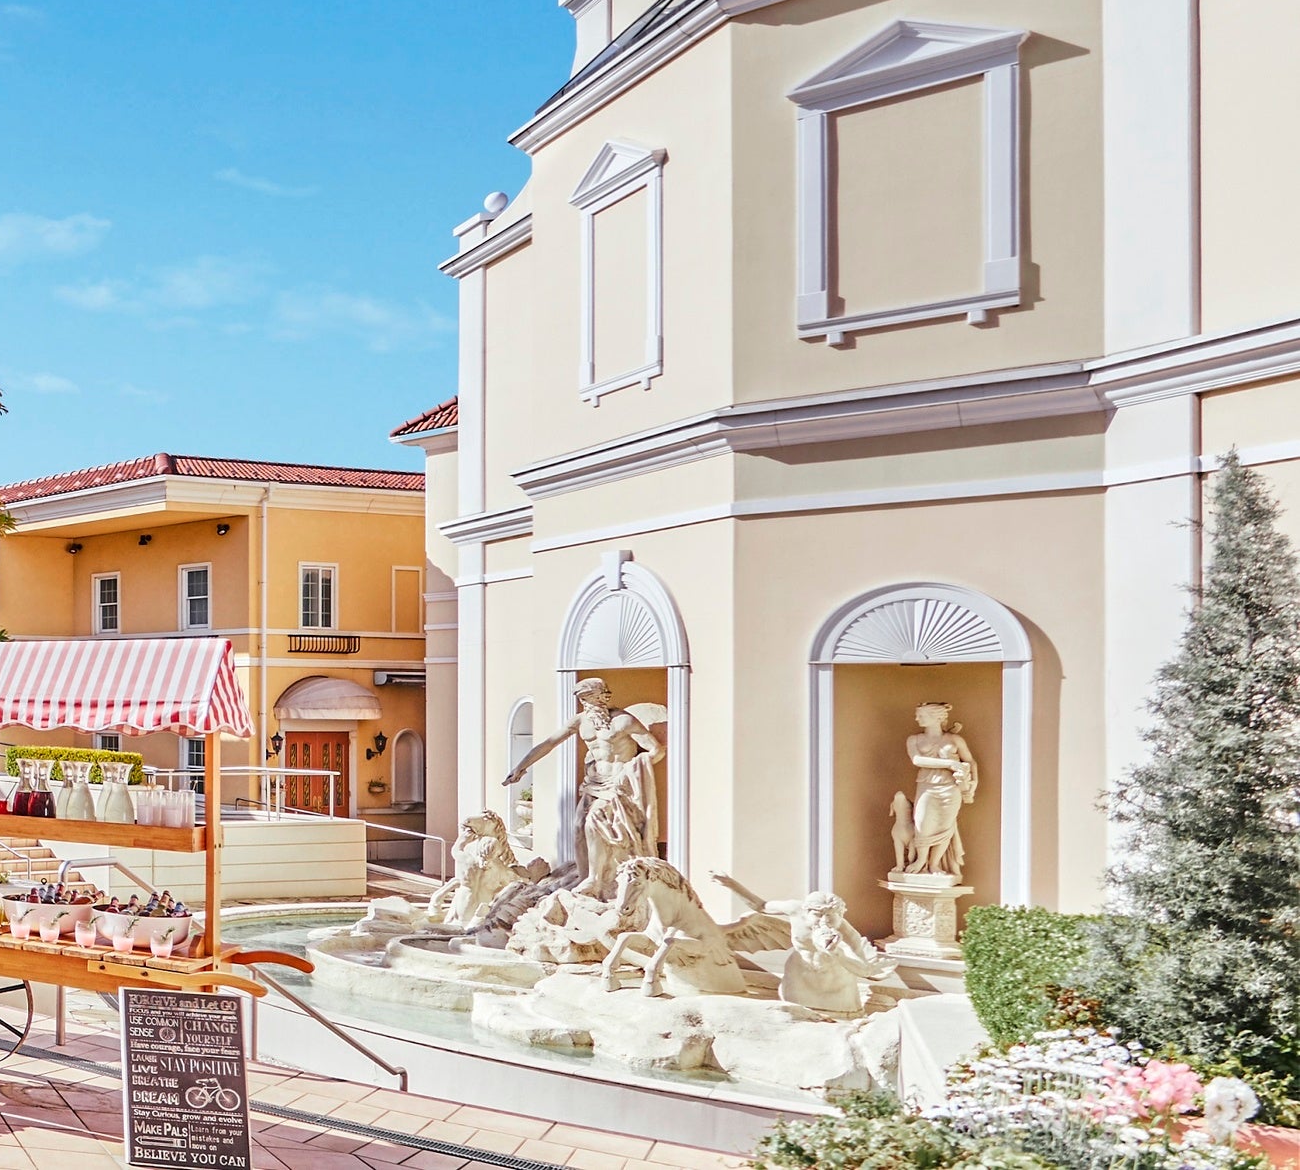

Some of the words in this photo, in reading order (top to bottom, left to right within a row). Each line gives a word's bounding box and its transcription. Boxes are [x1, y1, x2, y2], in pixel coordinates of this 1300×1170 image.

[128, 994, 177, 1007] FORGIVE
[179, 998, 199, 1009] and
[200, 999, 219, 1010] Let
[220, 1000, 238, 1011] GO
[129, 1016, 143, 1025] USE
[145, 1017, 179, 1027] COMMON
[184, 1020, 238, 1034] CHANGE
[129, 1027, 154, 1037] SENSE
[185, 1033, 233, 1046] YOURSELF
[130, 1041, 149, 1049] Have
[184, 1044, 201, 1052] face
[201, 1047, 220, 1055] your
[220, 1047, 240, 1056] fears
[131, 1064, 158, 1074] LIVE
[189, 1058, 240, 1077] POSITIVE
[131, 1075, 179, 1088] BREATHE
[132, 1090, 180, 1106] DREAM
[133, 1109, 151, 1117] Stay
[182, 1114, 201, 1122] grow
[202, 1114, 217, 1122] and
[218, 1116, 243, 1125] evolve
[190, 1125, 209, 1134] Learn
[212, 1127, 227, 1135] from
[229, 1129, 243, 1137] your
[191, 1135, 220, 1143] mistakes
[222, 1137, 234, 1145] and
[190, 1152, 217, 1165] YOU
[219, 1155, 246, 1167] CAN
